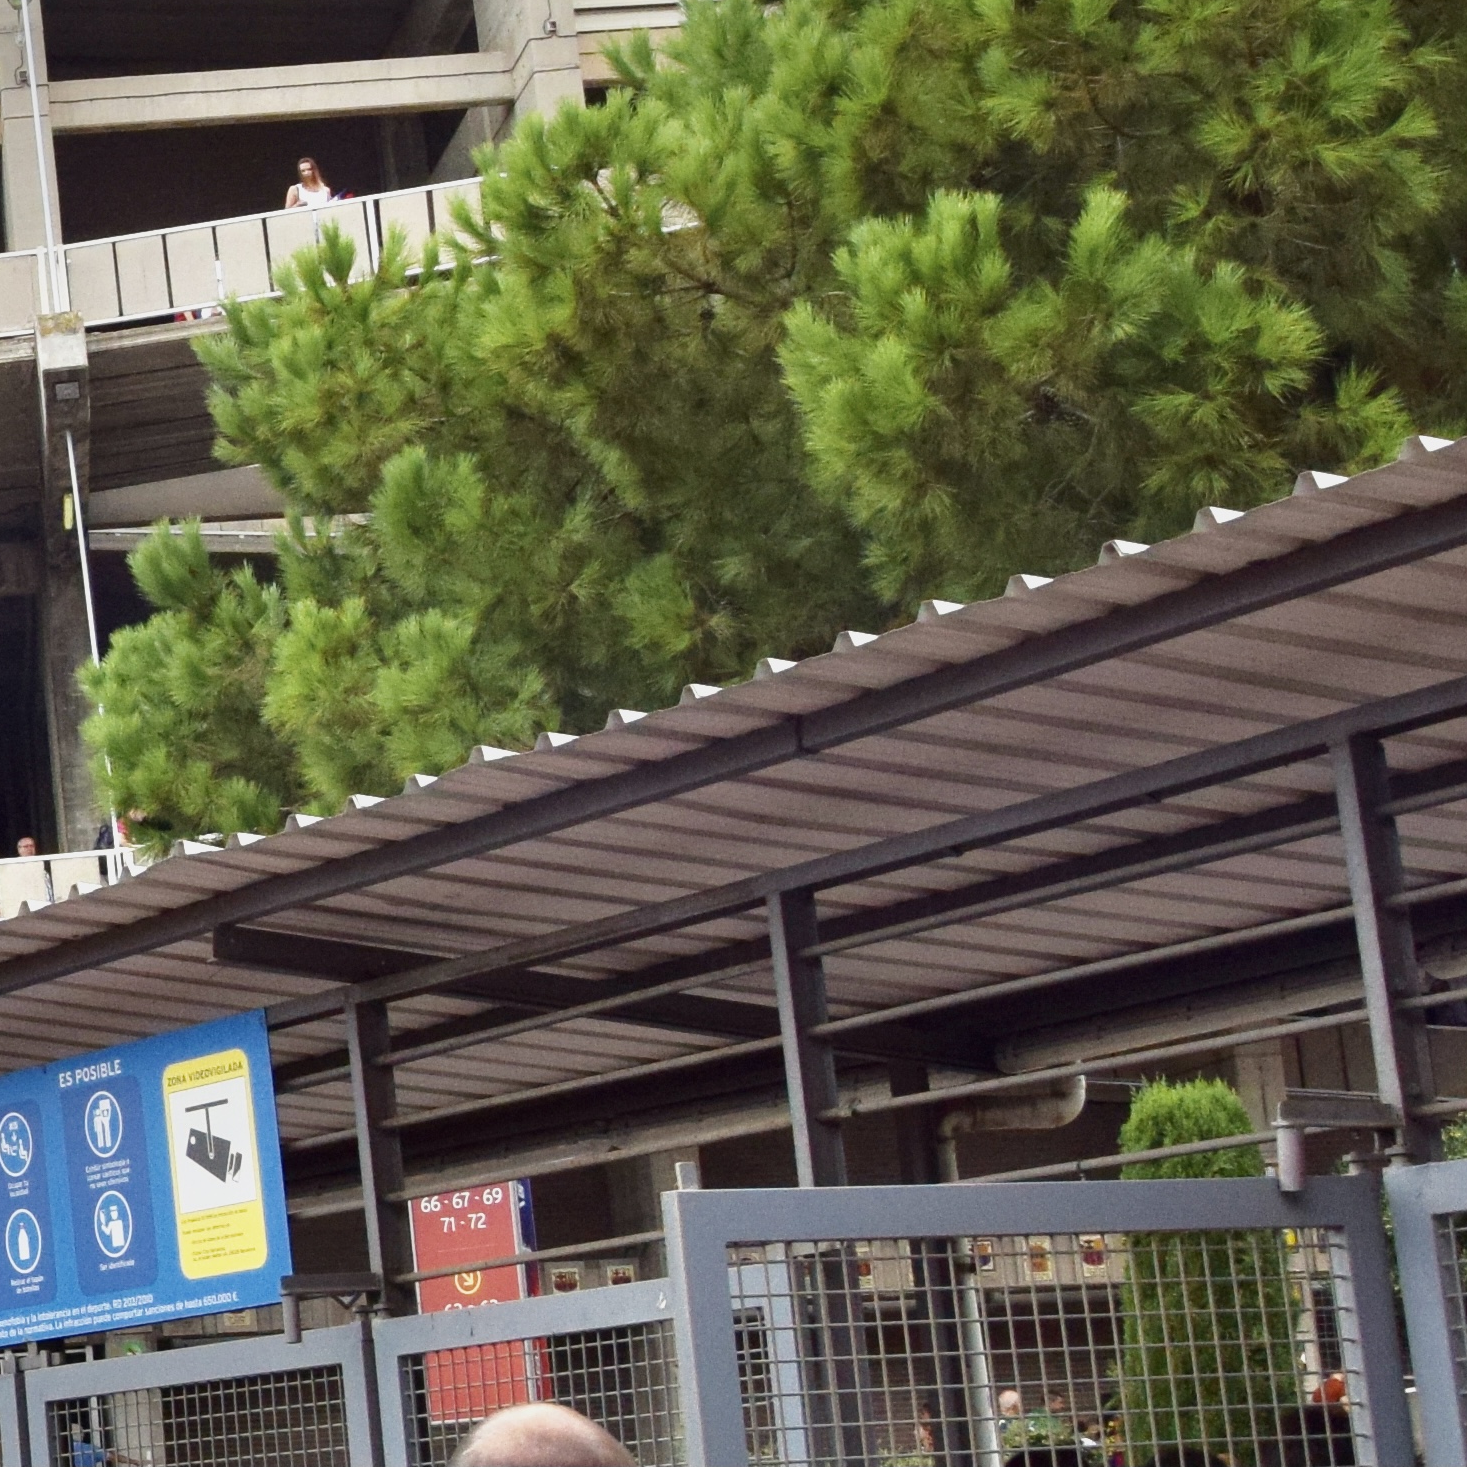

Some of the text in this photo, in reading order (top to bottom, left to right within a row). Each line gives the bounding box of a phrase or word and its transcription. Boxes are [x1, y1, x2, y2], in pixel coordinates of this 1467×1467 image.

[59, 1060, 122, 1088] ES POSIBLE
[167, 1061, 244, 1087] ZONA VIDEOVIGILADA
[420, 1196, 441, 1213] 66
[452, 1192, 470, 1209] 67
[482, 1187, 503, 1205] 69
[440, 1216, 456, 1233] 71
[467, 1212, 487, 1230] 72
